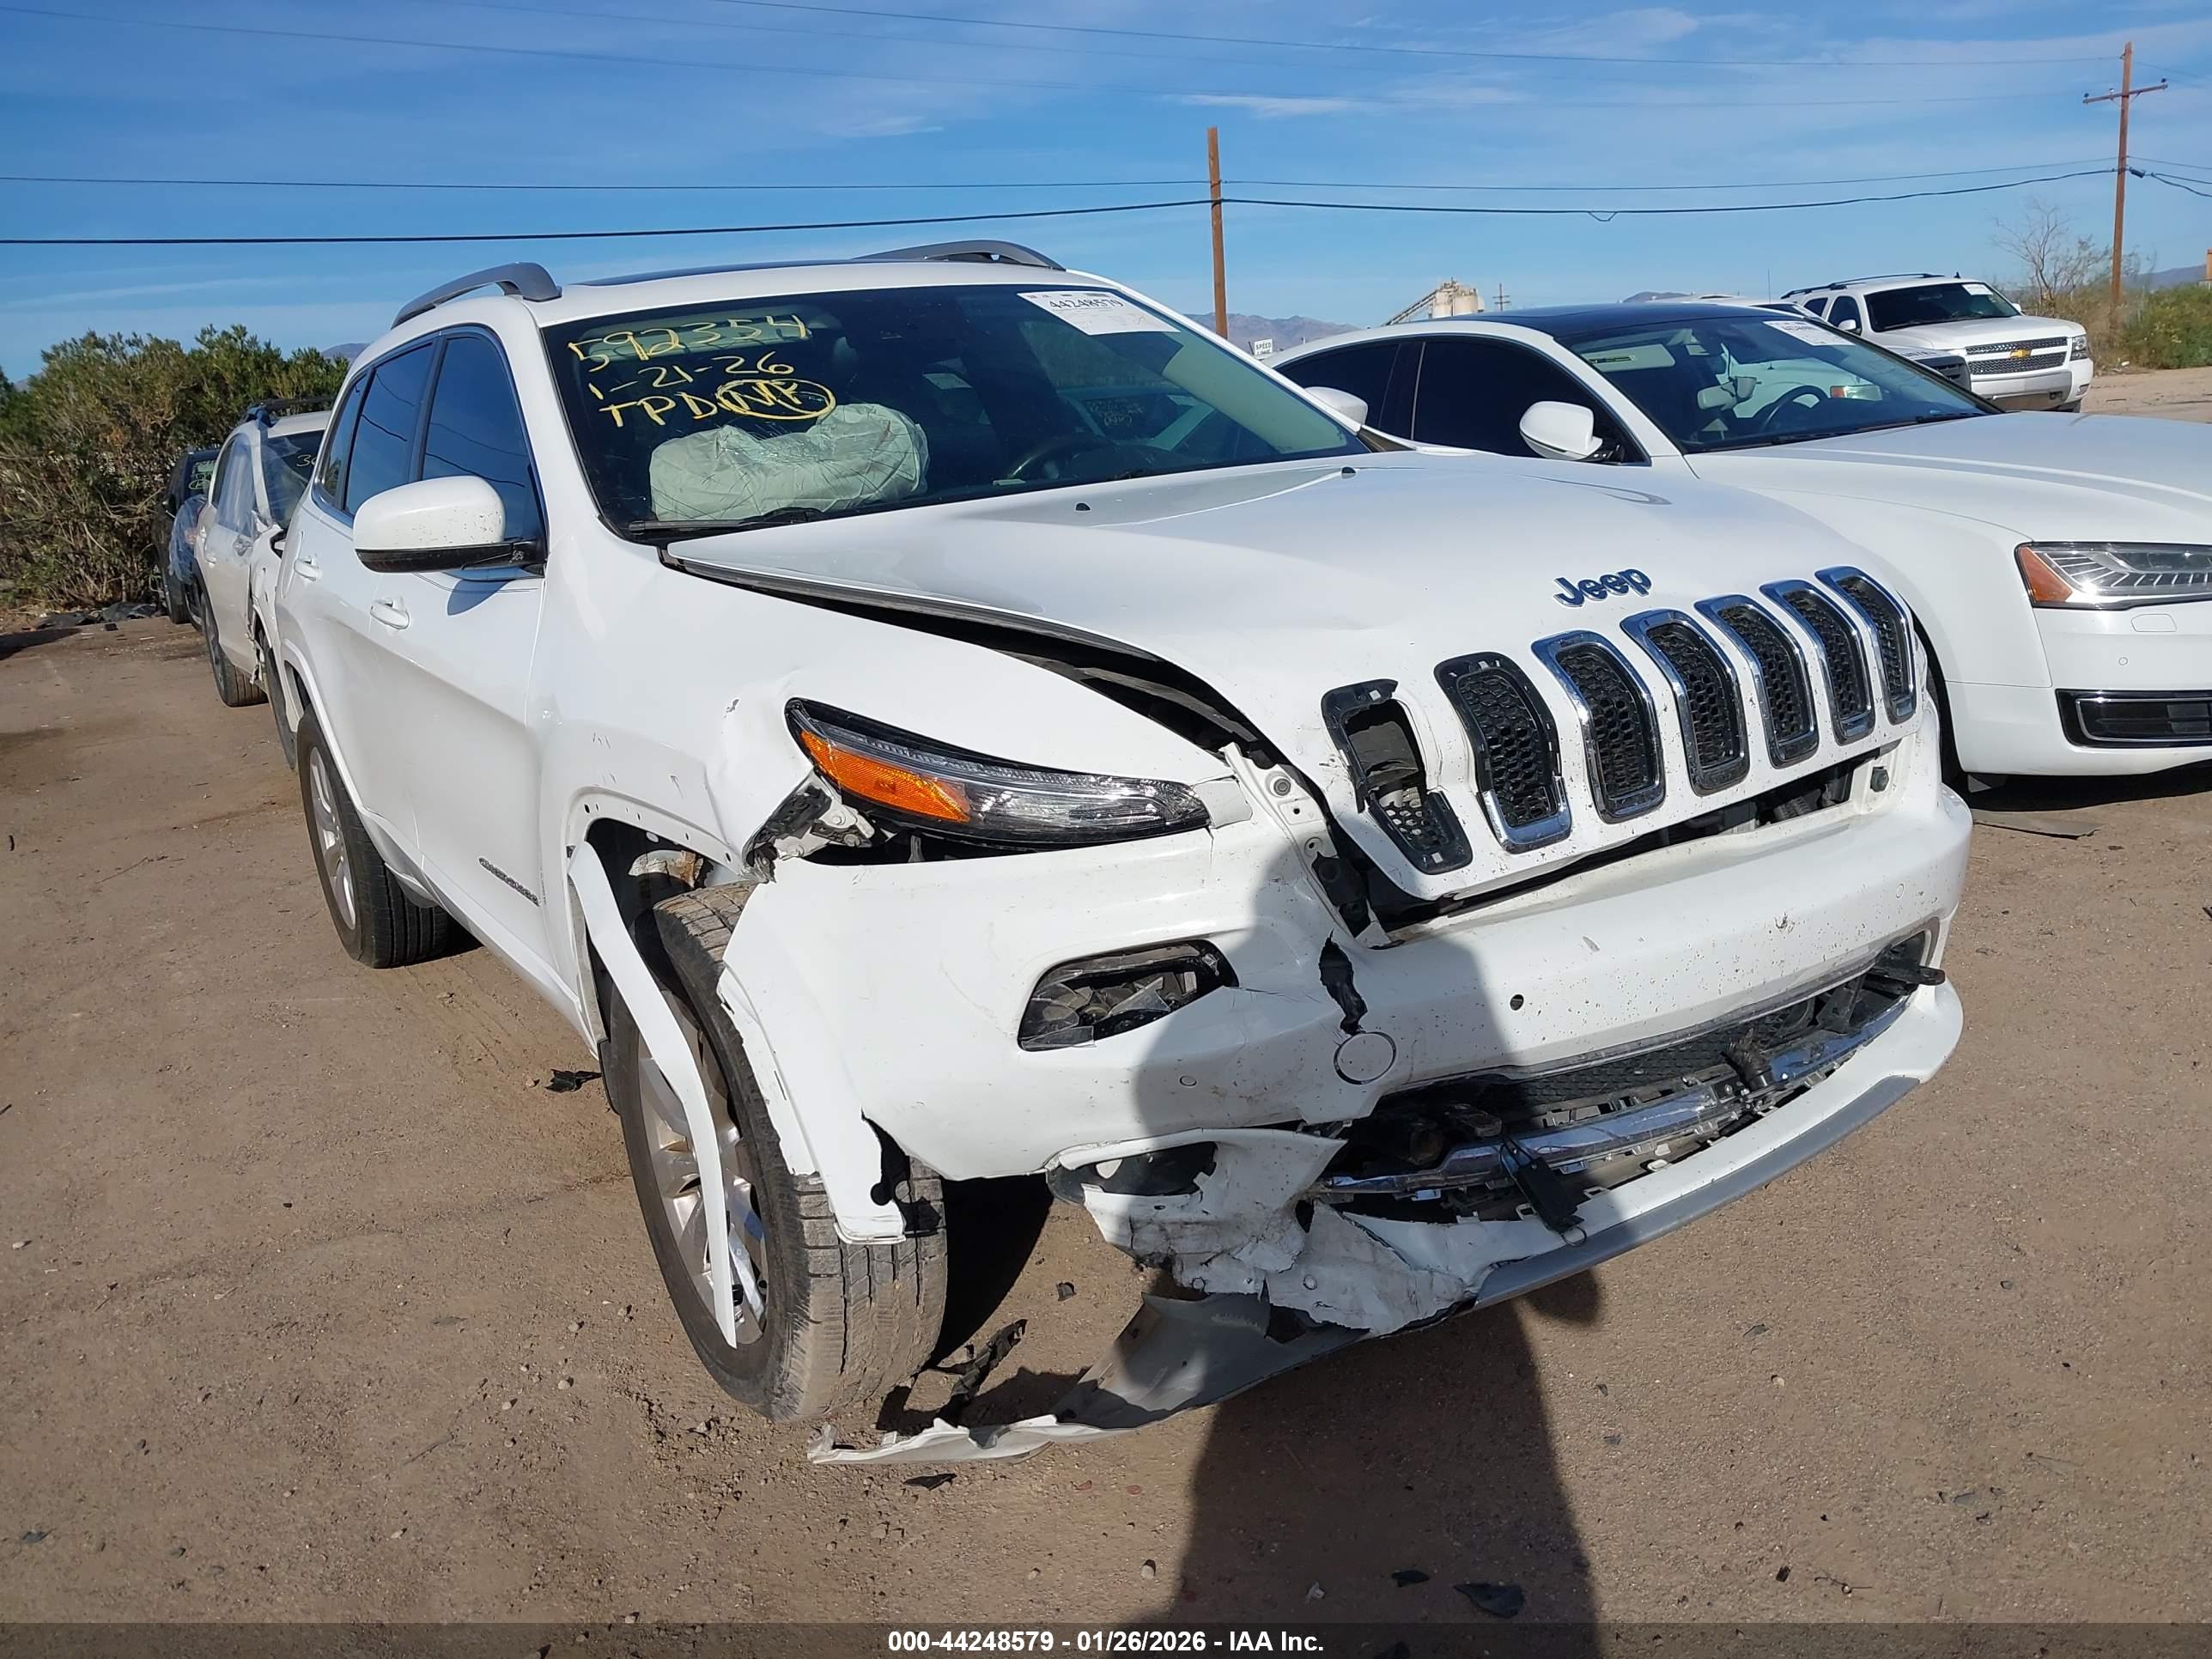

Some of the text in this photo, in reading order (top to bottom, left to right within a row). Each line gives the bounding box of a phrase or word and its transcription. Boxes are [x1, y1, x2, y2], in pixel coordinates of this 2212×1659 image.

[1049, 299, 1123, 308] 44248579
[568, 314, 809, 372] 592354
[1255, 342, 1272, 350] SPEED
[588, 351, 794, 399] 1-21-26
[599, 391, 719, 427] TPD
[1553, 568, 1652, 607] Jeep
